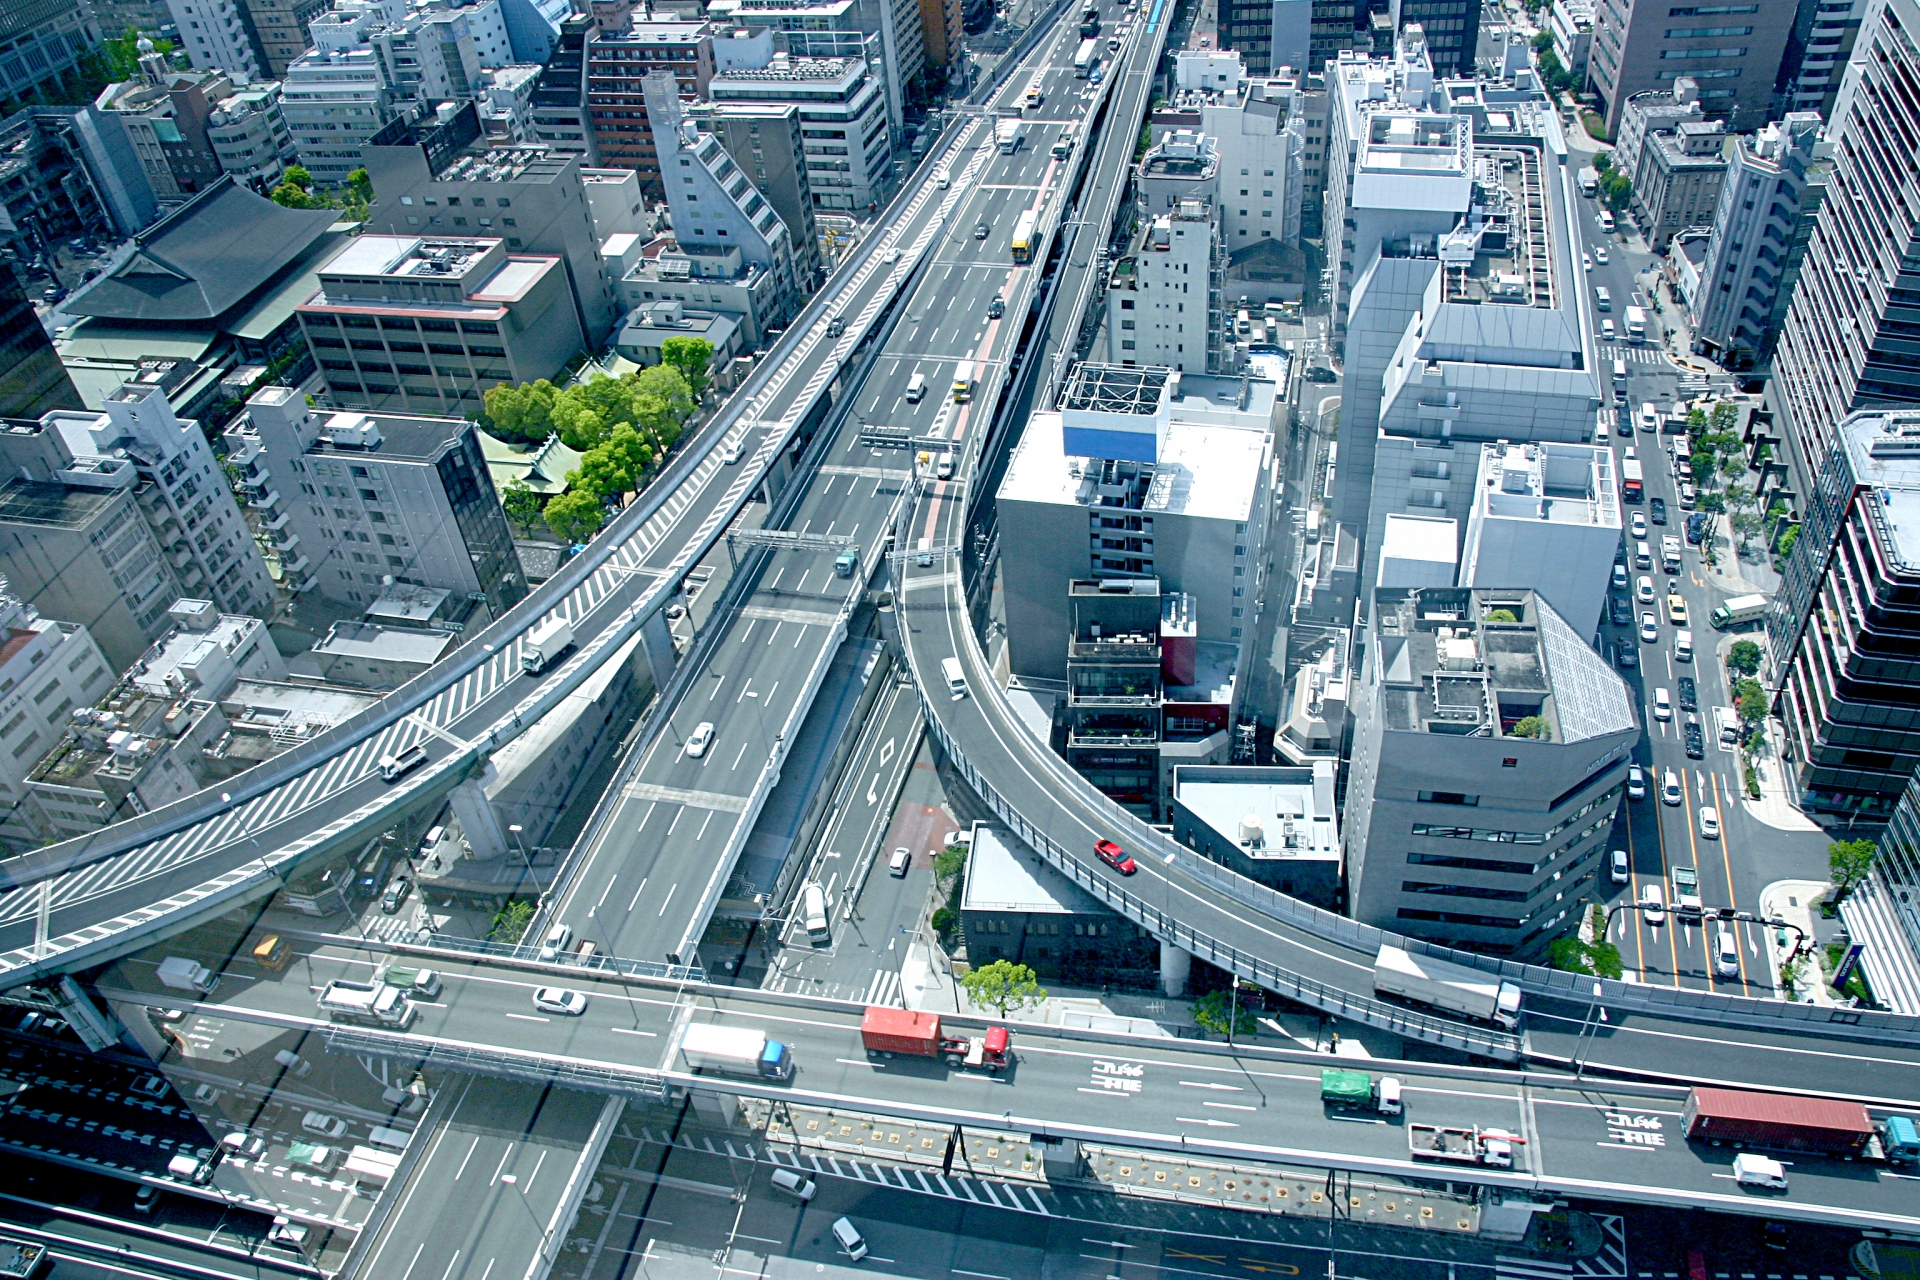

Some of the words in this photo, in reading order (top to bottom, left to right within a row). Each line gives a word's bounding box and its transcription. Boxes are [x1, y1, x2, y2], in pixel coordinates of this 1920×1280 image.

[1839, 954, 1855, 977] OLYMPUS
[1090, 1060, 1144, 1092] 湾岸
[1605, 1111, 1666, 1147] 湾岸
